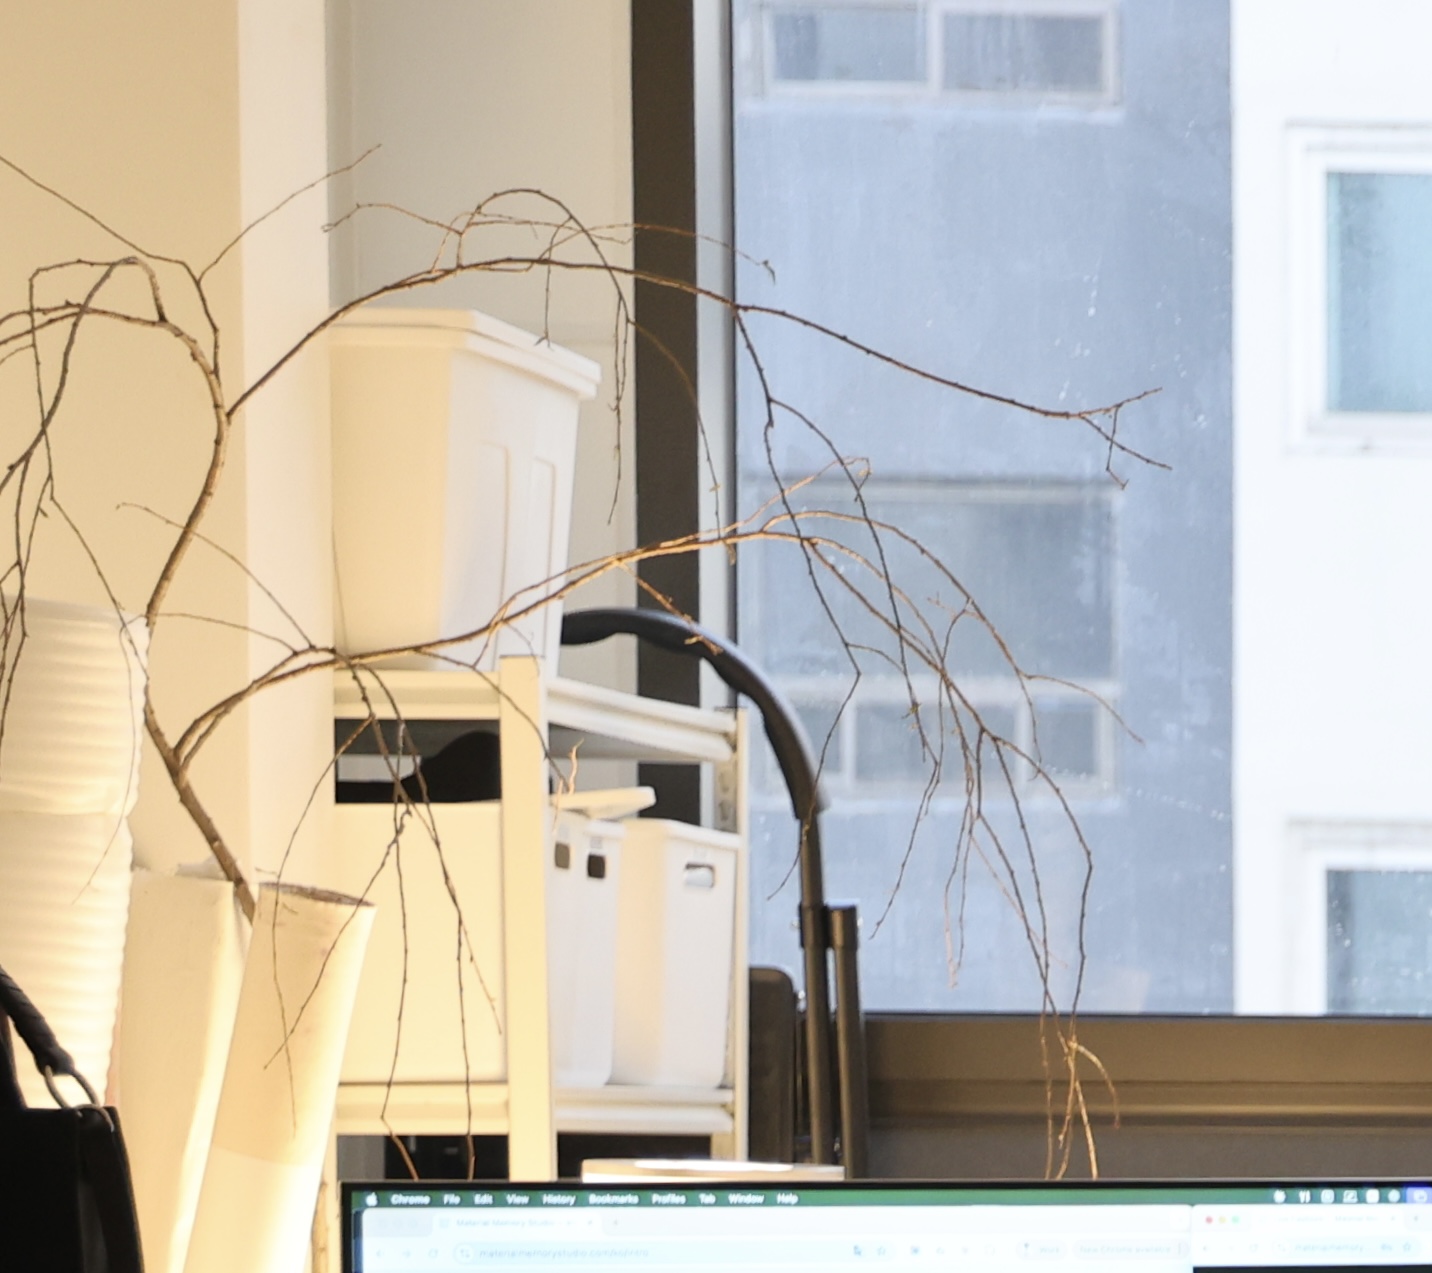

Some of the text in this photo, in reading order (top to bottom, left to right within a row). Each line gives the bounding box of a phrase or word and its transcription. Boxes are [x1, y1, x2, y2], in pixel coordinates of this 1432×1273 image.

[390, 1193, 798, 1207] Chrome File Edit View History Bookmarks Profiles Tab Window Help
